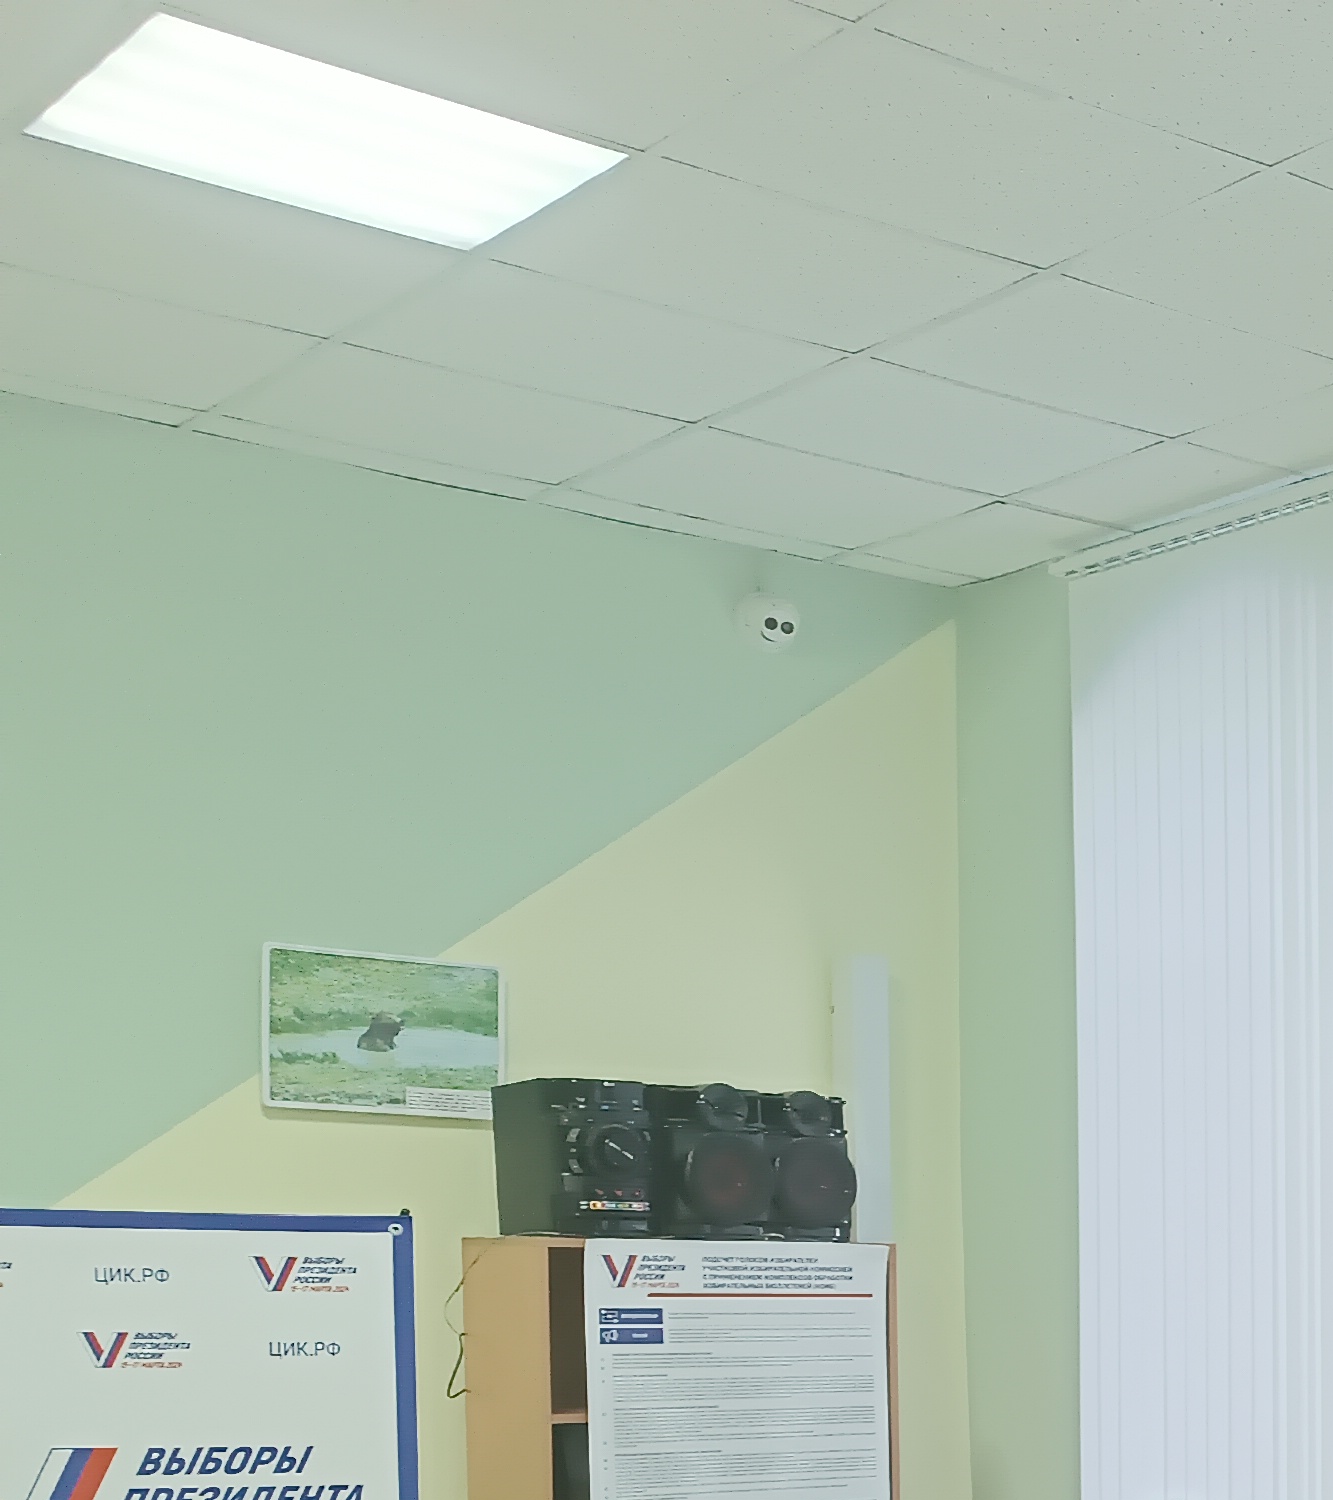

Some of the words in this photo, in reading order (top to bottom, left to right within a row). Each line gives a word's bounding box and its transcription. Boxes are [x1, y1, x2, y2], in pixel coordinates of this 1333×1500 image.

[95, 1268, 169, 1285] ЦИК.РФ
[269, 1342, 340, 1359] ЦИК.РФ
[136, 1446, 314, 1476] ВЫБОРЫ
